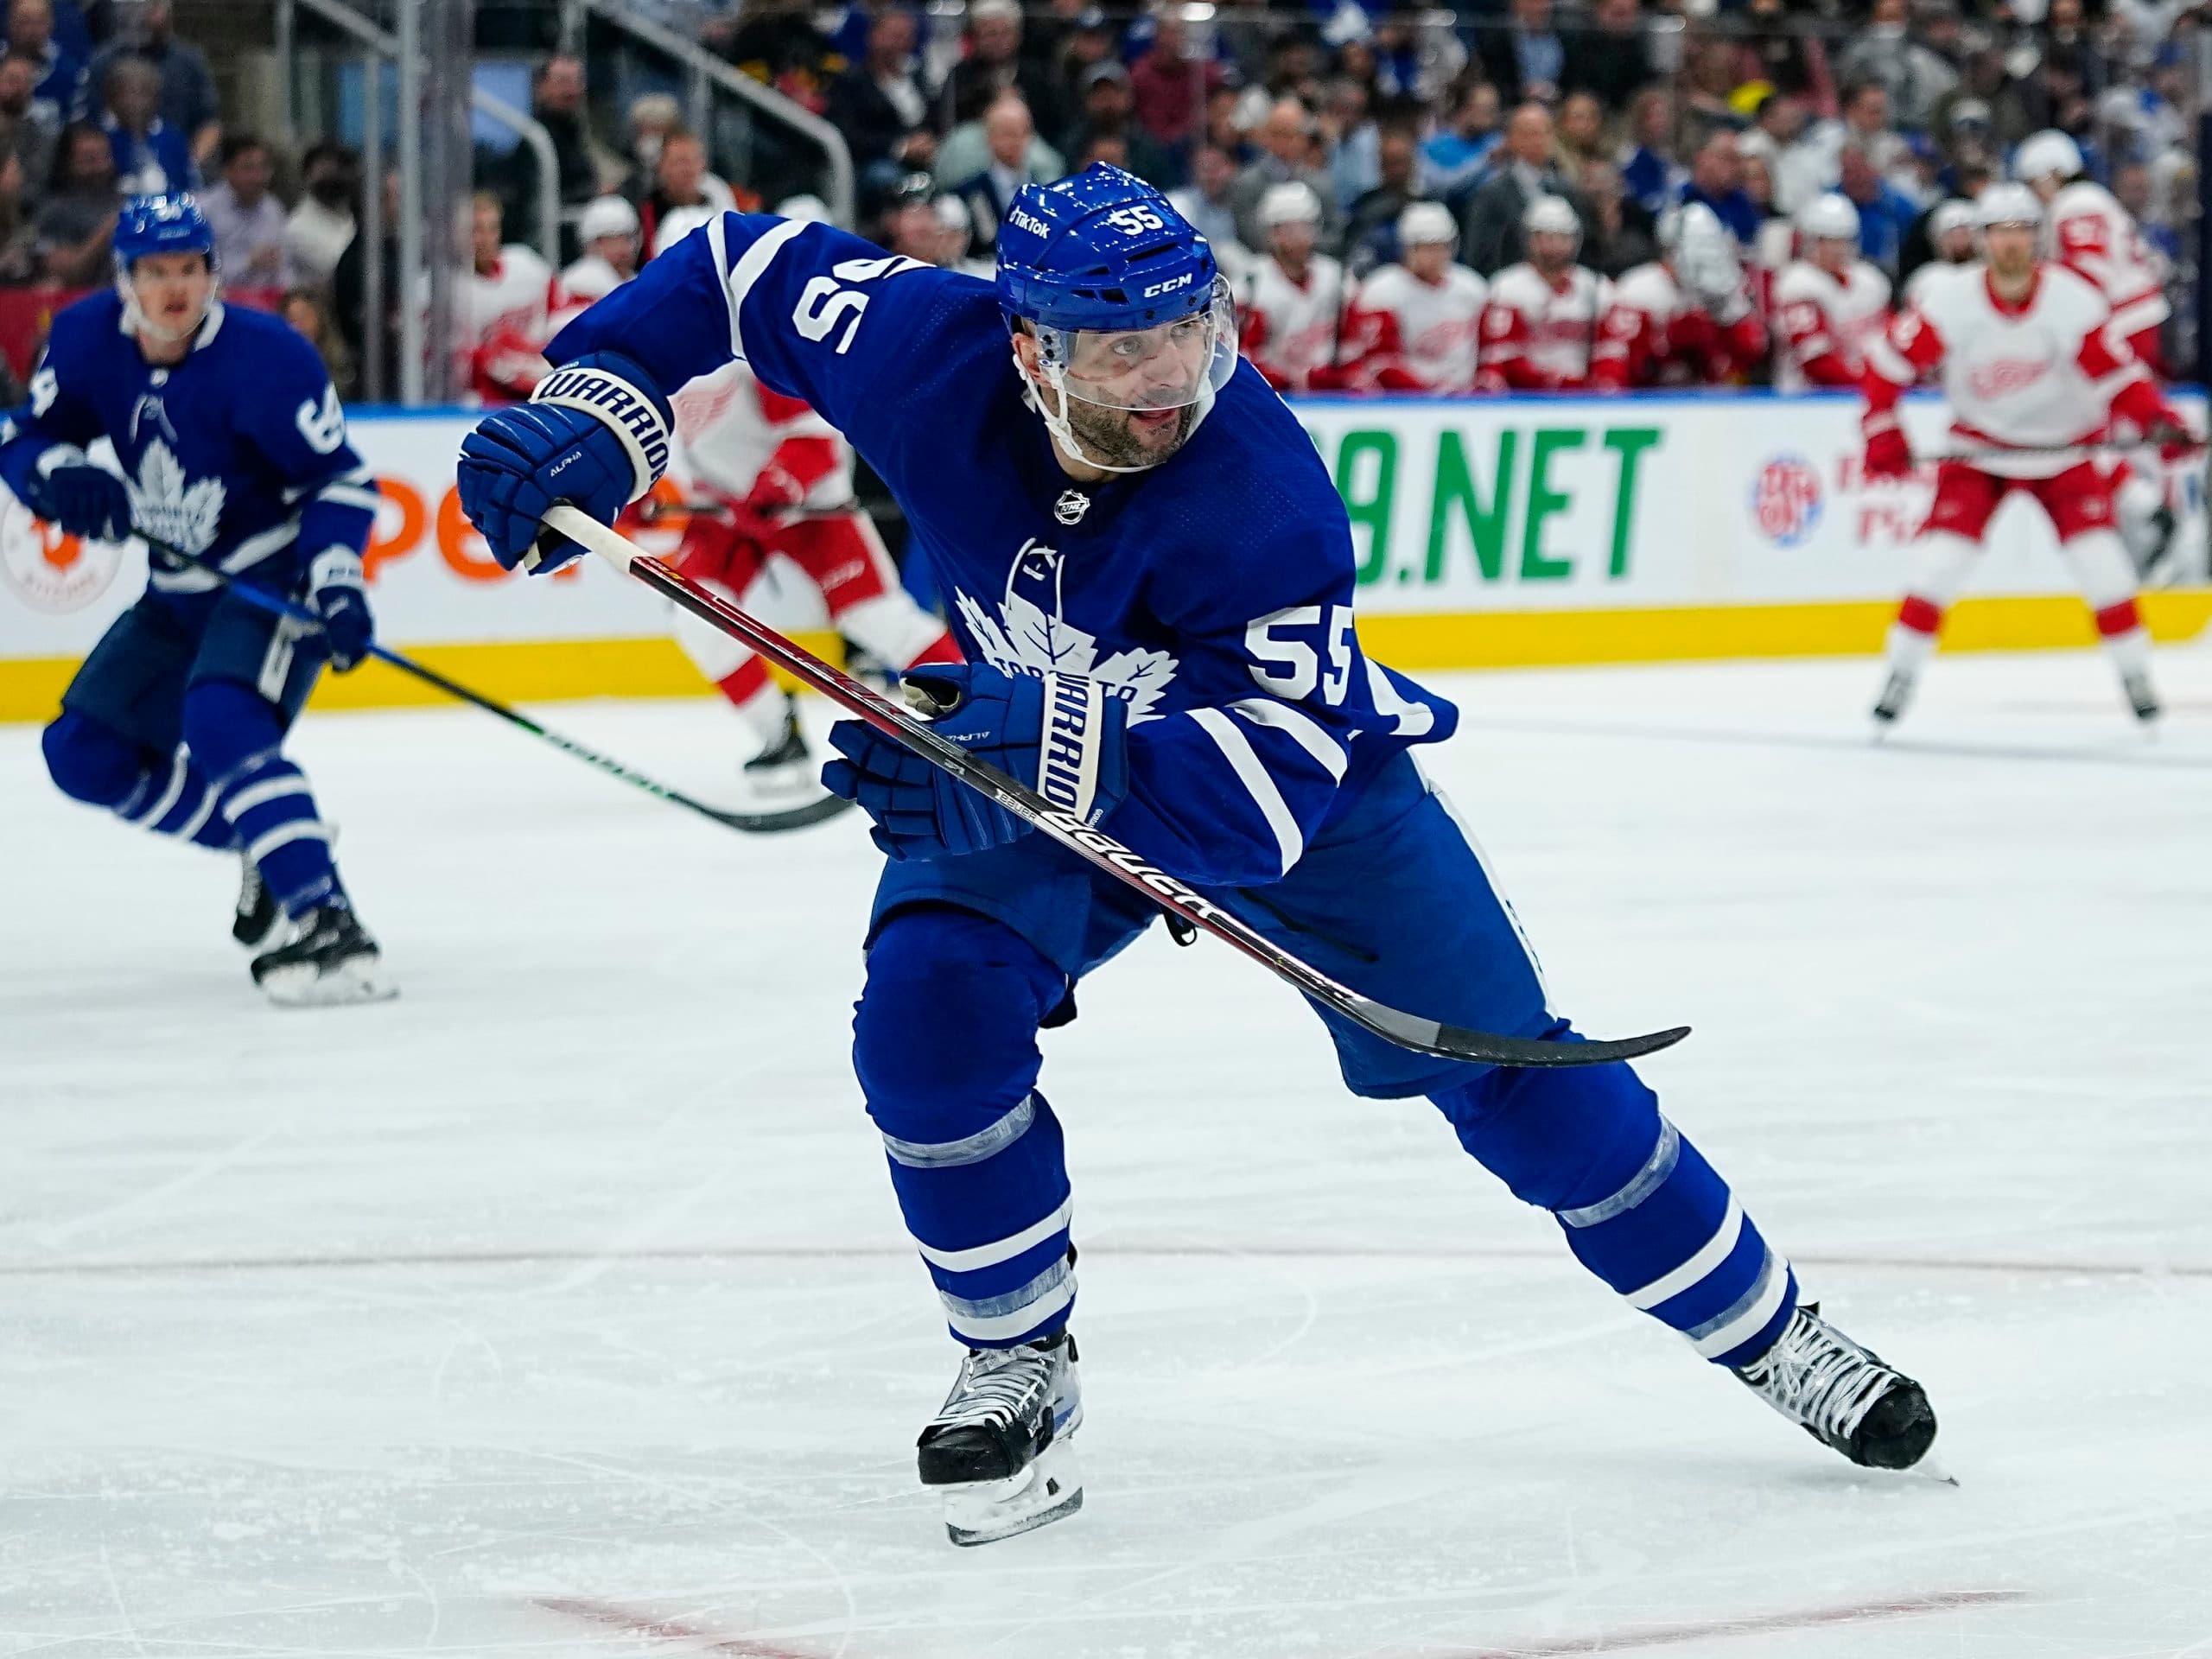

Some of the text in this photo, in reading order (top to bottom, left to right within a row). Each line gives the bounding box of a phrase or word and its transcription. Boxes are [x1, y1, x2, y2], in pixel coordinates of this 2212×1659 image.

[1014, 209, 1051, 239] TikTok
[1109, 205, 1164, 236] 55
[1143, 272, 1193, 299] CCM
[550, 451, 582, 478] ALPHA
[1309, 428, 1662, 588] 9.NET
[1244, 604, 1353, 707] 55
[1044, 670, 1090, 815] WARRIO
[999, 792, 1039, 820] BAUER
